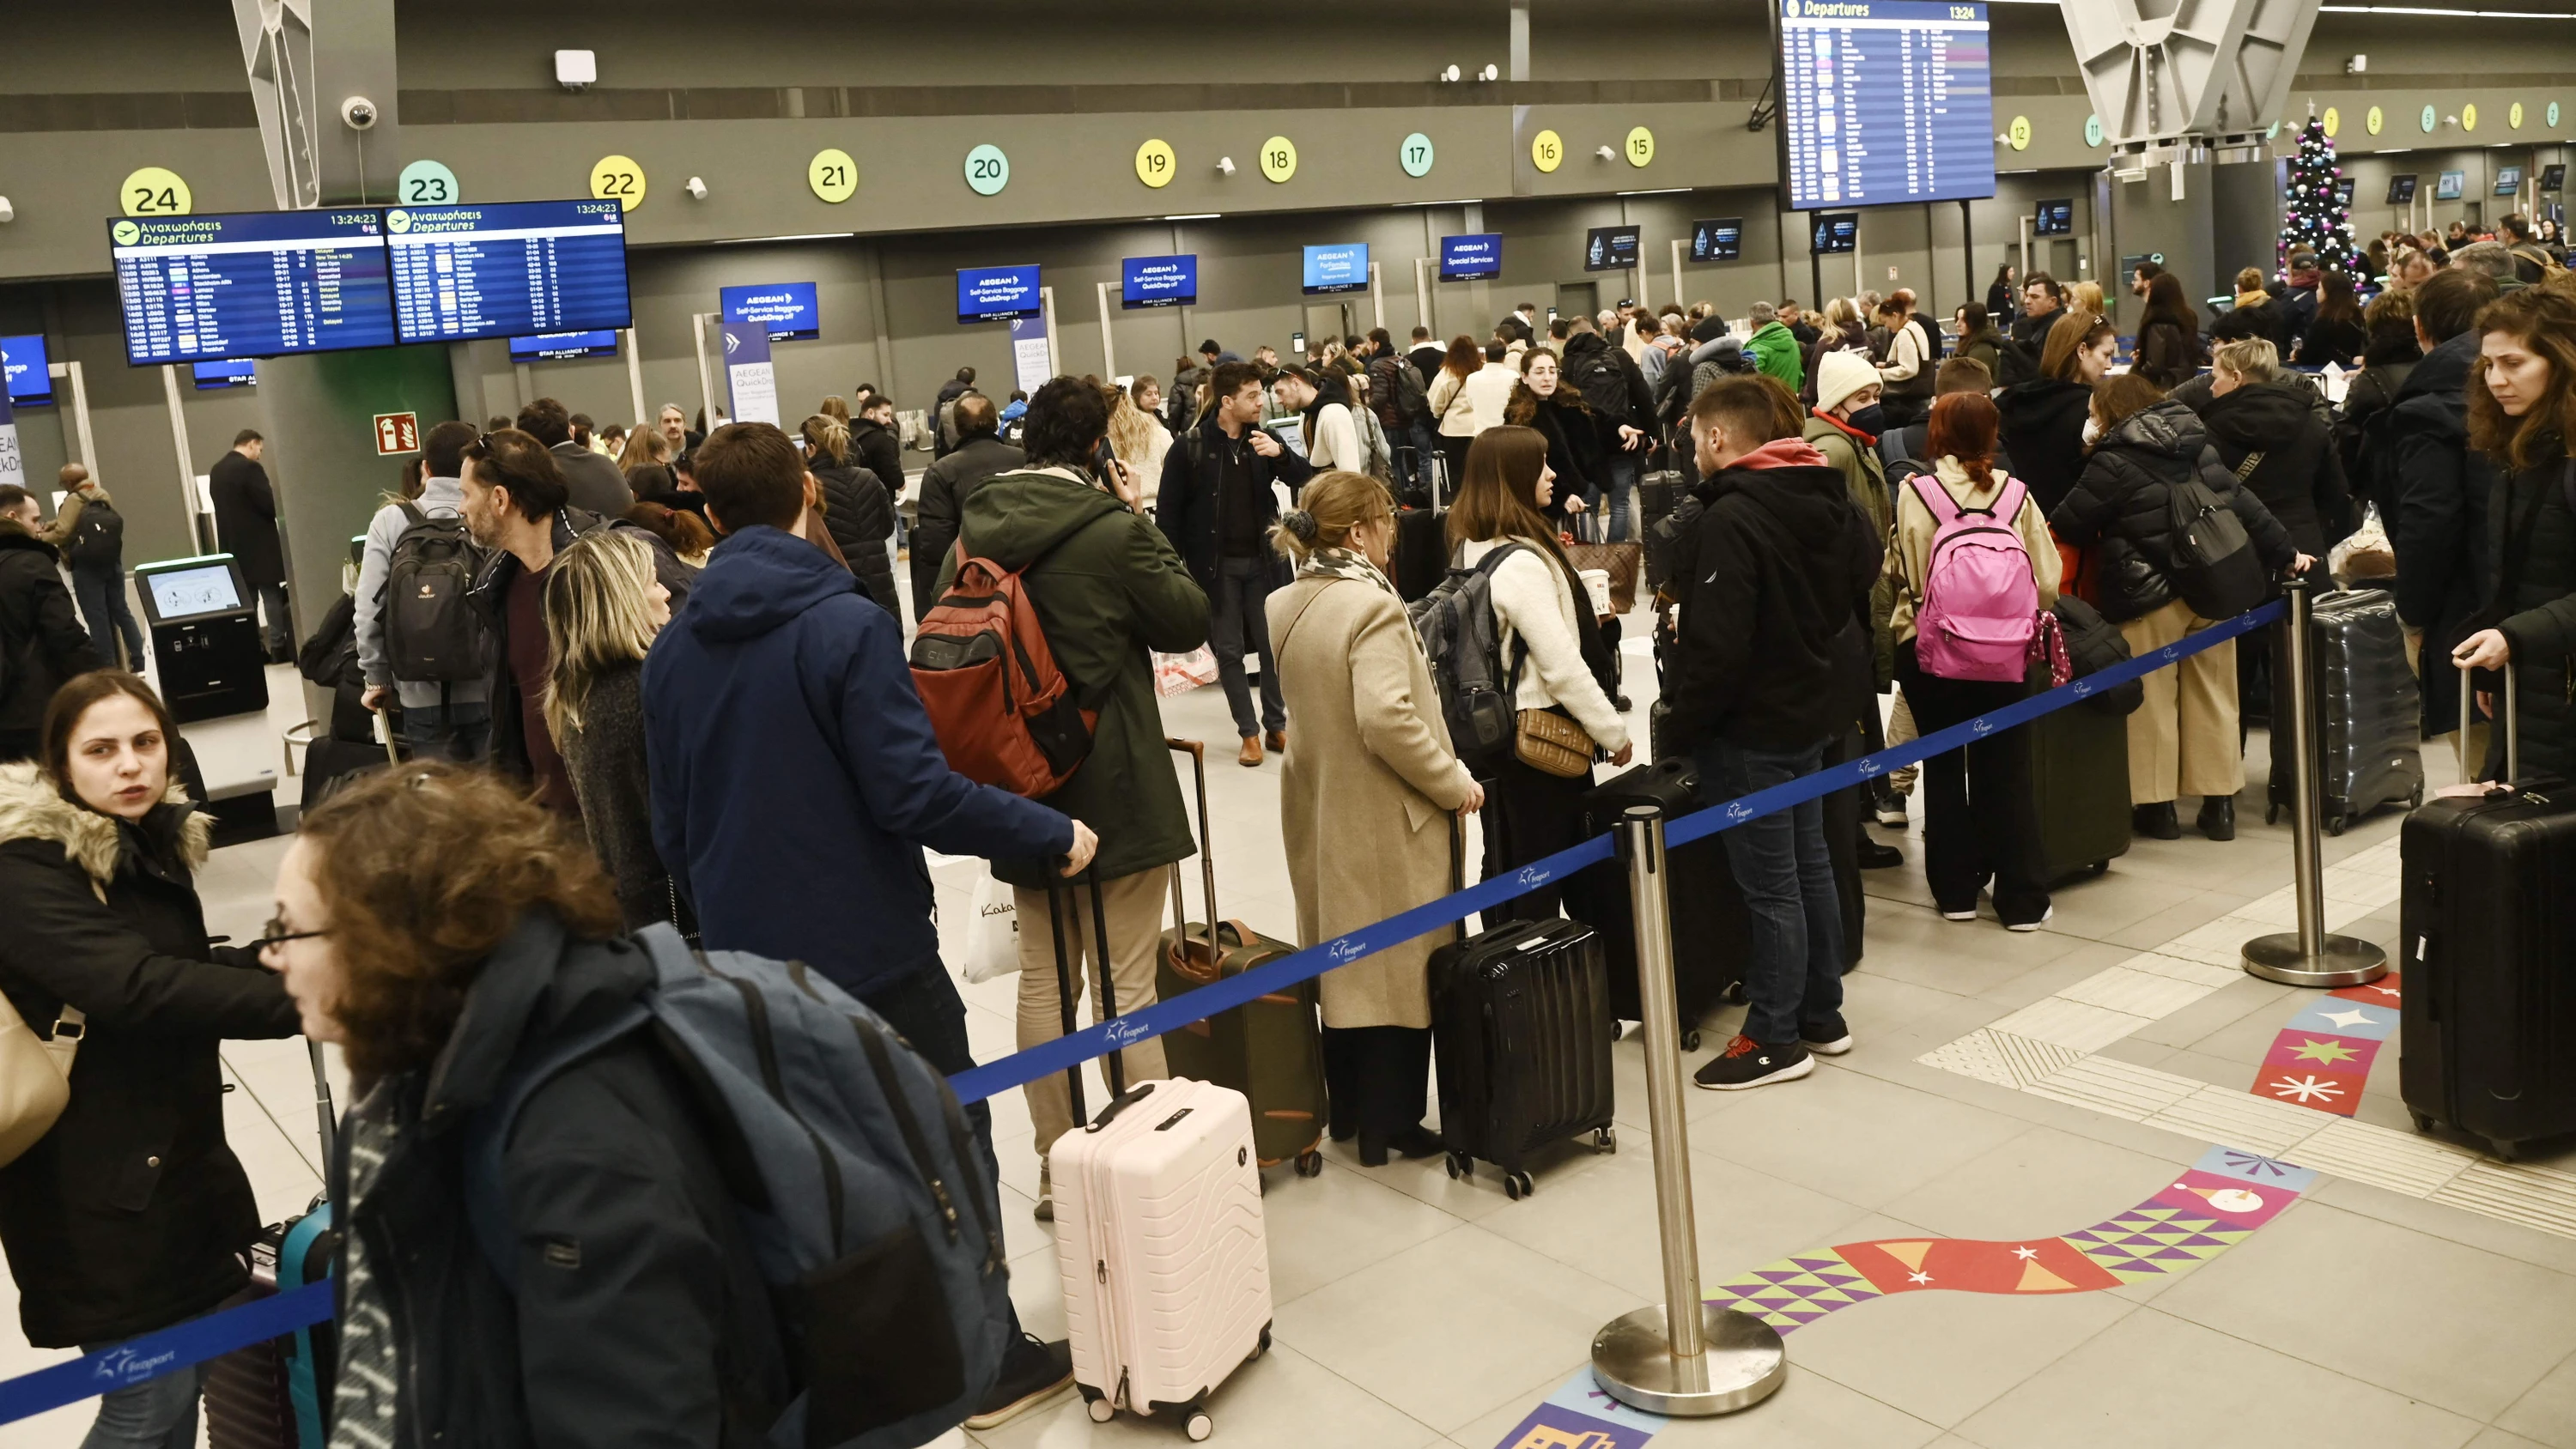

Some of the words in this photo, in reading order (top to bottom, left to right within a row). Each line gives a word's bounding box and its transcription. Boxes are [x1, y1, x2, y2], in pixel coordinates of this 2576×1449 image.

[1804, 1, 1869, 17] Departures
[1949, 7, 1975, 20] 13:24
[2015, 127, 2025, 139] 12
[2091, 124, 2099, 136] 11
[1540, 143, 1555, 159] 16
[1633, 139, 1647, 155] 15
[1269, 151, 1288, 168] 18
[1409, 147, 1425, 163] 17
[974, 159, 1001, 179] 20
[1146, 155, 1166, 172] 19
[821, 166, 845, 186] 21
[410, 178, 447, 202] 23
[602, 173, 635, 195] 22
[134, 188, 179, 212] 24
[410, 210, 482, 221] Αναχωρήσεις
[577, 204, 617, 214] 13:24:23
[141, 221, 222, 233] Αναχωρήσεις
[331, 215, 377, 225] 13:24:23
[413, 221, 475, 233] Departures
[143, 233, 214, 246] Departures
[1448, 258, 1469, 266] Special
[979, 277, 1012, 286] AEGEAN
[1002, 286, 1028, 294] Baggage
[746, 295, 784, 305] AEGEAN
[979, 294, 1011, 303] QuickDrop
[736, 305, 773, 315] Self-Service
[775, 305, 804, 313] Baggage
[747, 313, 784, 322] QuickDrop
[1738, 808, 1753, 817] Fraport
[1532, 871, 1550, 882] Fraport
[1345, 943, 1366, 955] Fraport
[1124, 1023, 1149, 1038] Fraport
[128, 1350, 175, 1373] Fraport
